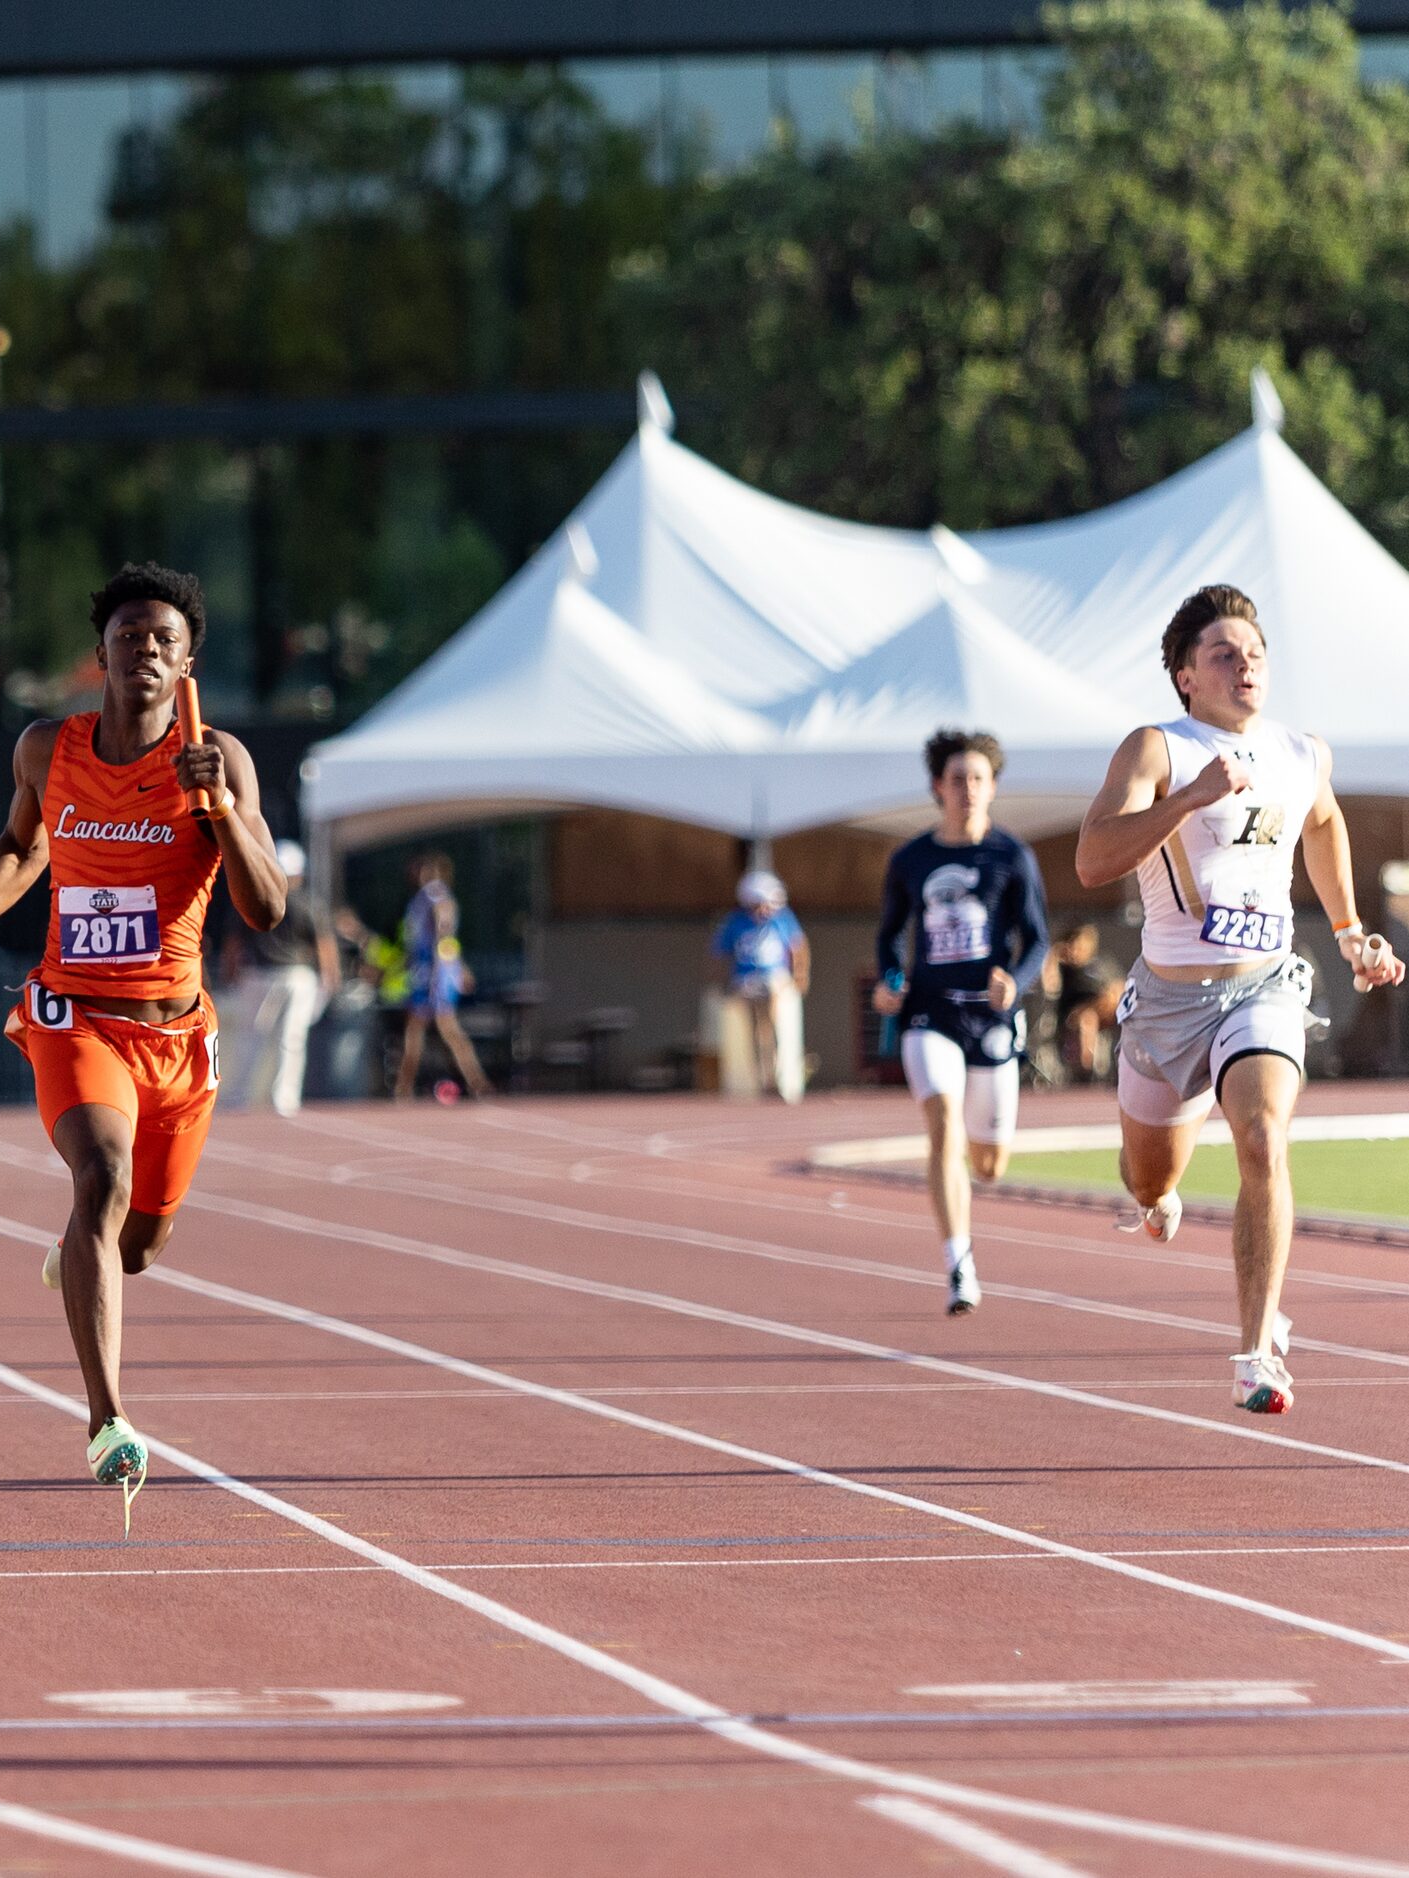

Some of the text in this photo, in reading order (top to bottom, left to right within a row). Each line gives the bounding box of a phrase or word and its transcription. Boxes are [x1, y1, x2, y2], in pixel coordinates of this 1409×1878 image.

[53, 803, 176, 845] Lancaster
[89, 898, 120, 906] STATE
[71, 916, 146, 955] 2871
[1210, 909, 1279, 950] 2235
[37, 987, 67, 1025] 6
